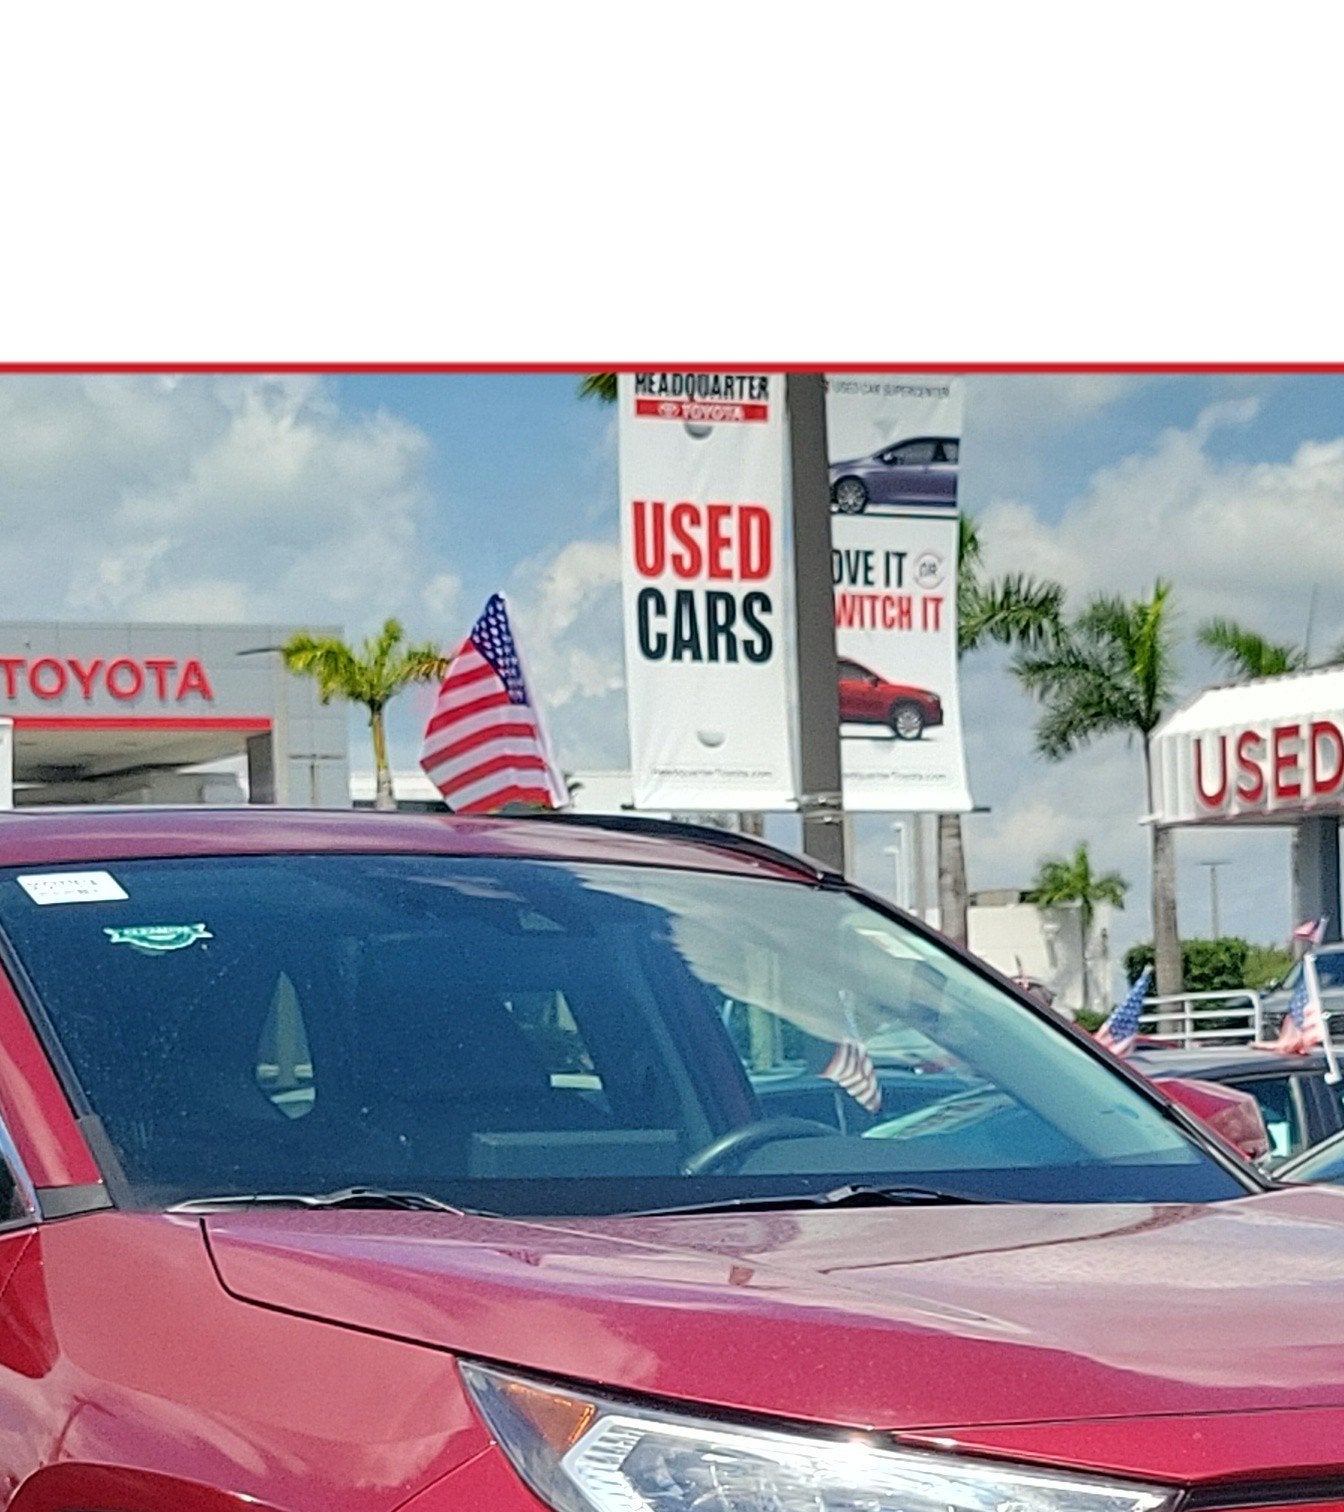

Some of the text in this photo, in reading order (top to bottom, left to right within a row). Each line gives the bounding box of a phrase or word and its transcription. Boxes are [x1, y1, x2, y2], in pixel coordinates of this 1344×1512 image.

[635, 373, 770, 402] HEADQUARTER
[632, 501, 772, 580] USED
[831, 549, 907, 588] OVE IT
[637, 587, 773, 663] CARS
[834, 593, 943, 632] WITCH IT
